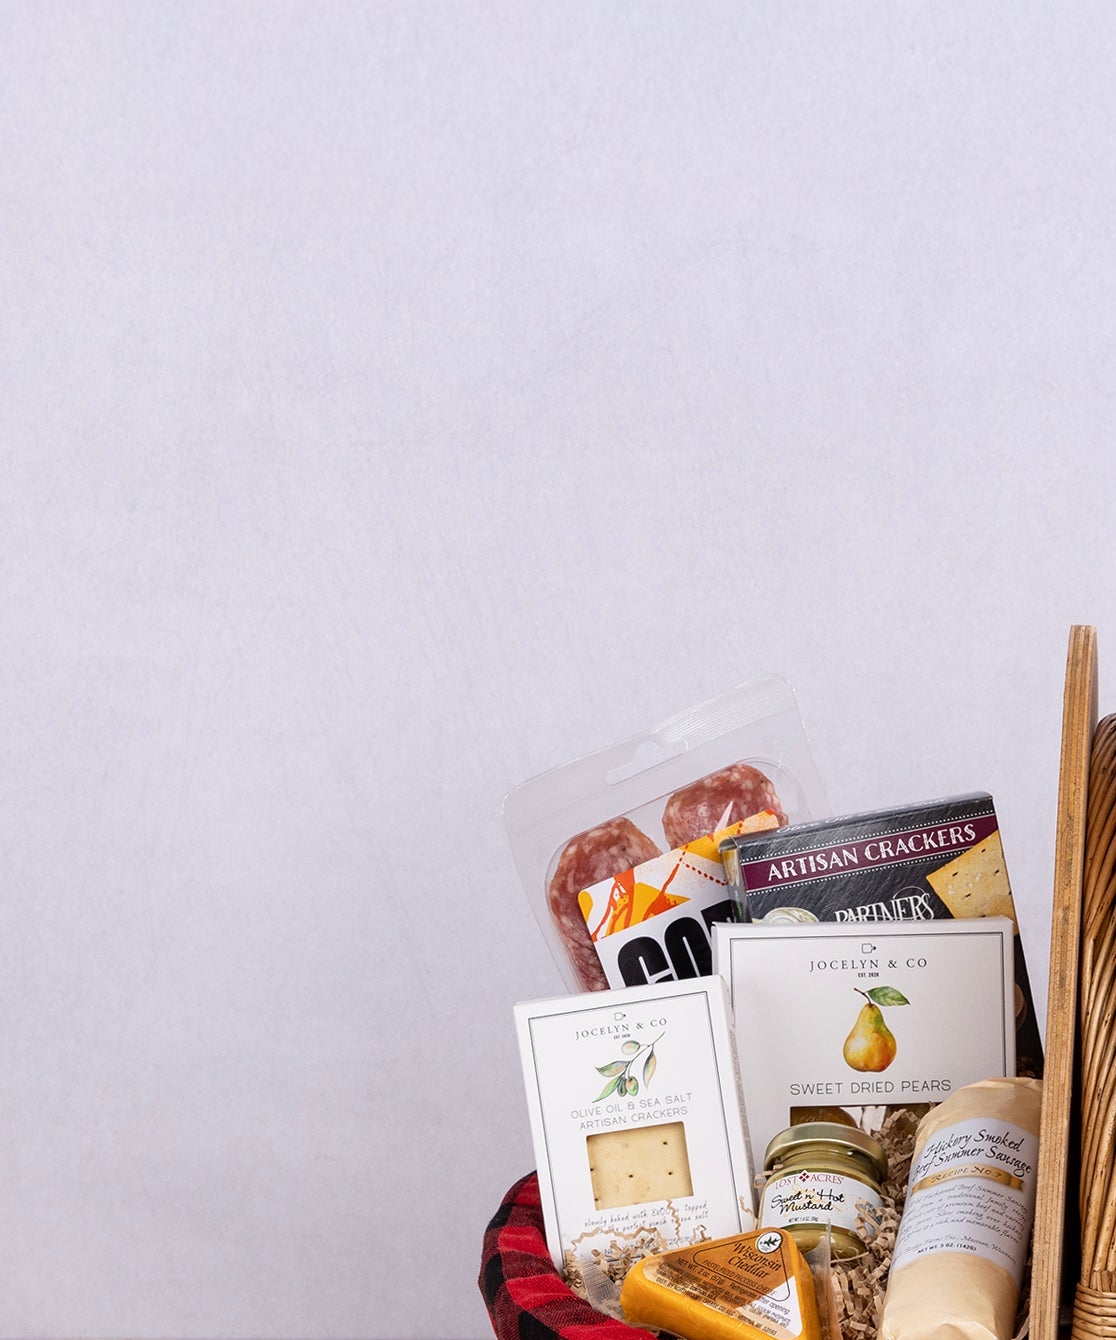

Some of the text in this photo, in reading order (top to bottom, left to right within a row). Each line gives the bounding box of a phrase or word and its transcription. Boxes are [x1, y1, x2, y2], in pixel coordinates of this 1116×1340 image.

[767, 823, 977, 882] ARTISAN CRACKERS
[834, 886, 935, 922] PARTNERS
[810, 957, 928, 972] JOCELYN & CO
[576, 1023, 630, 1040] JOCELYN
[650, 1017, 668, 1028] CO
[790, 1079, 952, 1095] SWEET DRIED PEARS
[570, 1092, 693, 1119] OLIVE OIL & SEA SALT
[580, 1106, 689, 1130] ARTISAN CRACKERS
[924, 1128, 1025, 1159] Hickory Smoked
[934, 1146, 984, 1168] Summer
[985, 1145, 1033, 1177] Sausage
[775, 1173, 845, 1190] LOST ACRES
[931, 1165, 969, 1183] RECIPE
[771, 1190, 803, 1209] Sweet
[816, 1188, 845, 1203] Hot
[780, 1201, 834, 1216] Mustard
[584, 1214, 608, 1227] slowly
[610, 1210, 630, 1223] baked
[632, 1208, 648, 1220] with
[695, 1210, 709, 1220] salt
[728, 1255, 770, 1279] Cheddar
[733, 1241, 782, 1272] Wisconsin
[676, 1257, 689, 1267] NET
[769, 1301, 790, 1315] opening
